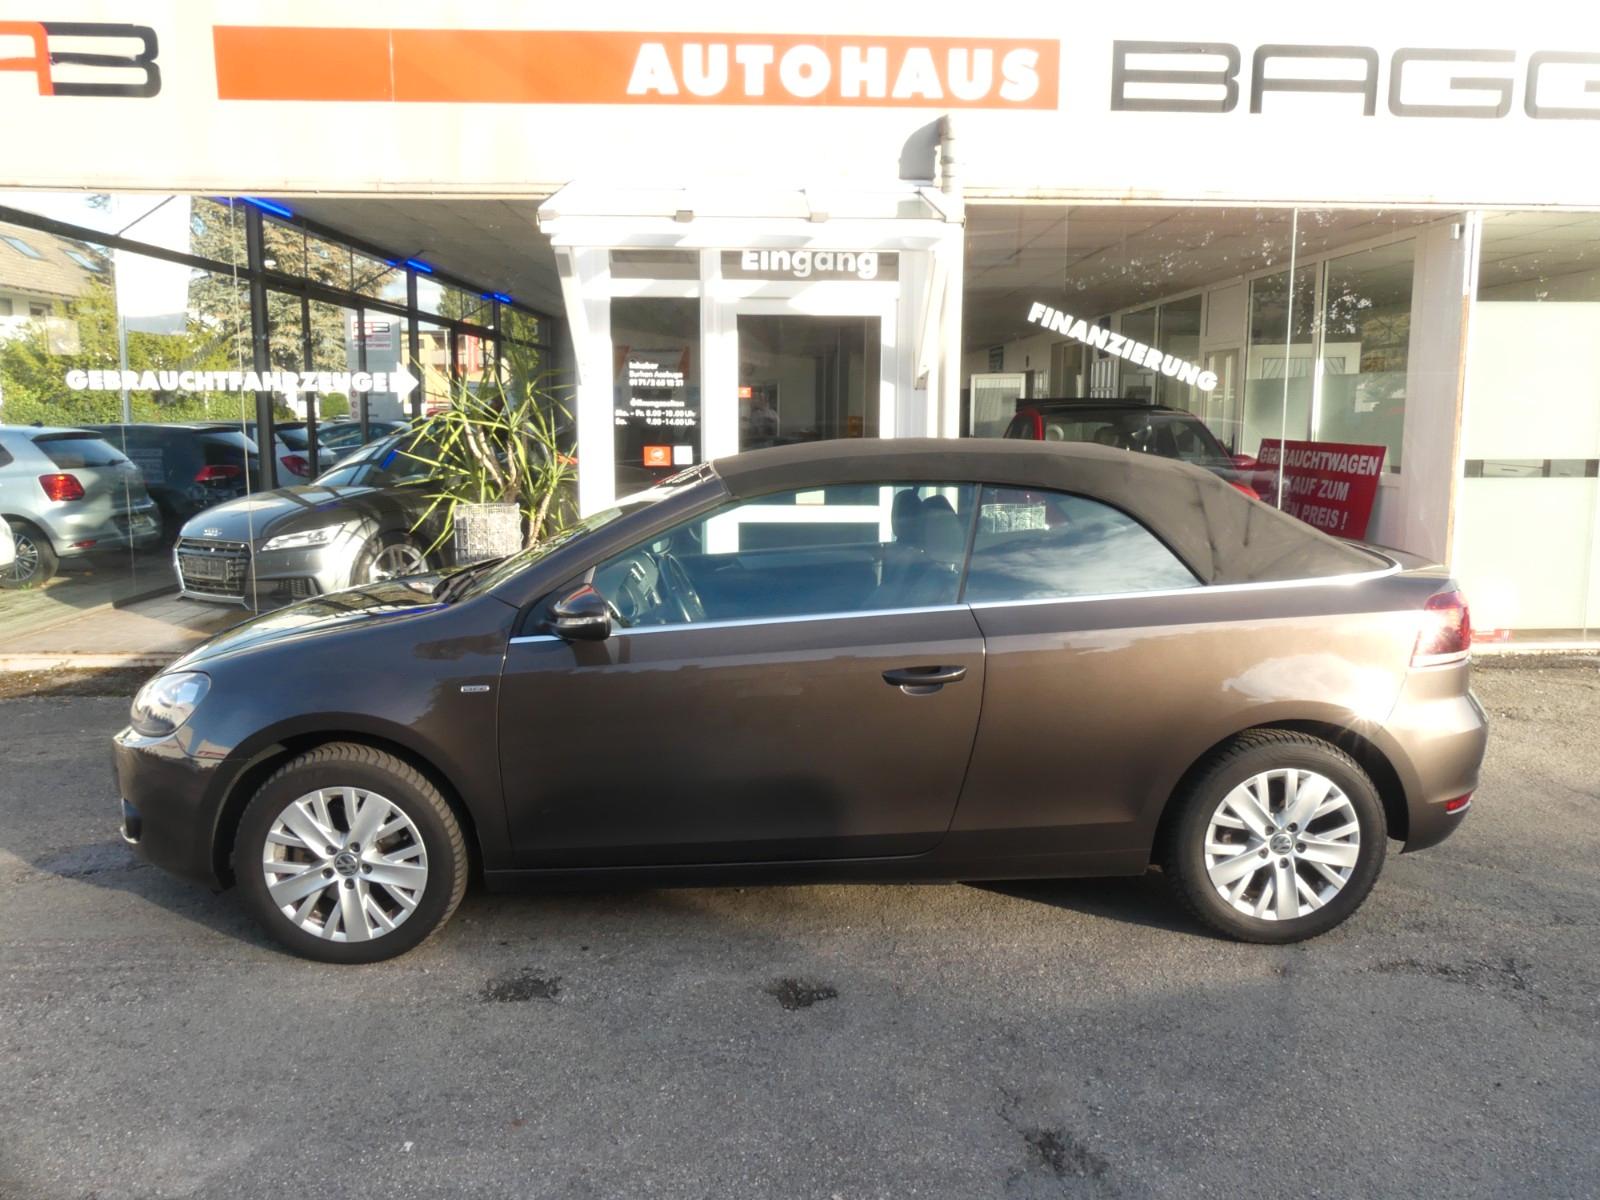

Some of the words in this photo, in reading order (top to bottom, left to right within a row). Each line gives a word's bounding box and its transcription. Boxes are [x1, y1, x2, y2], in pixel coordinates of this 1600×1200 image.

[625, 42, 1041, 102] AUTOHAUS
[741, 250, 878, 280] Eingang
[1027, 301, 1218, 392] FINANZIERUNG
[65, 369, 388, 393] GEBRAUCHTFAHRZEUGE
[1318, 481, 1350, 501] ZUM
[1301, 504, 1340, 529] PREIS
